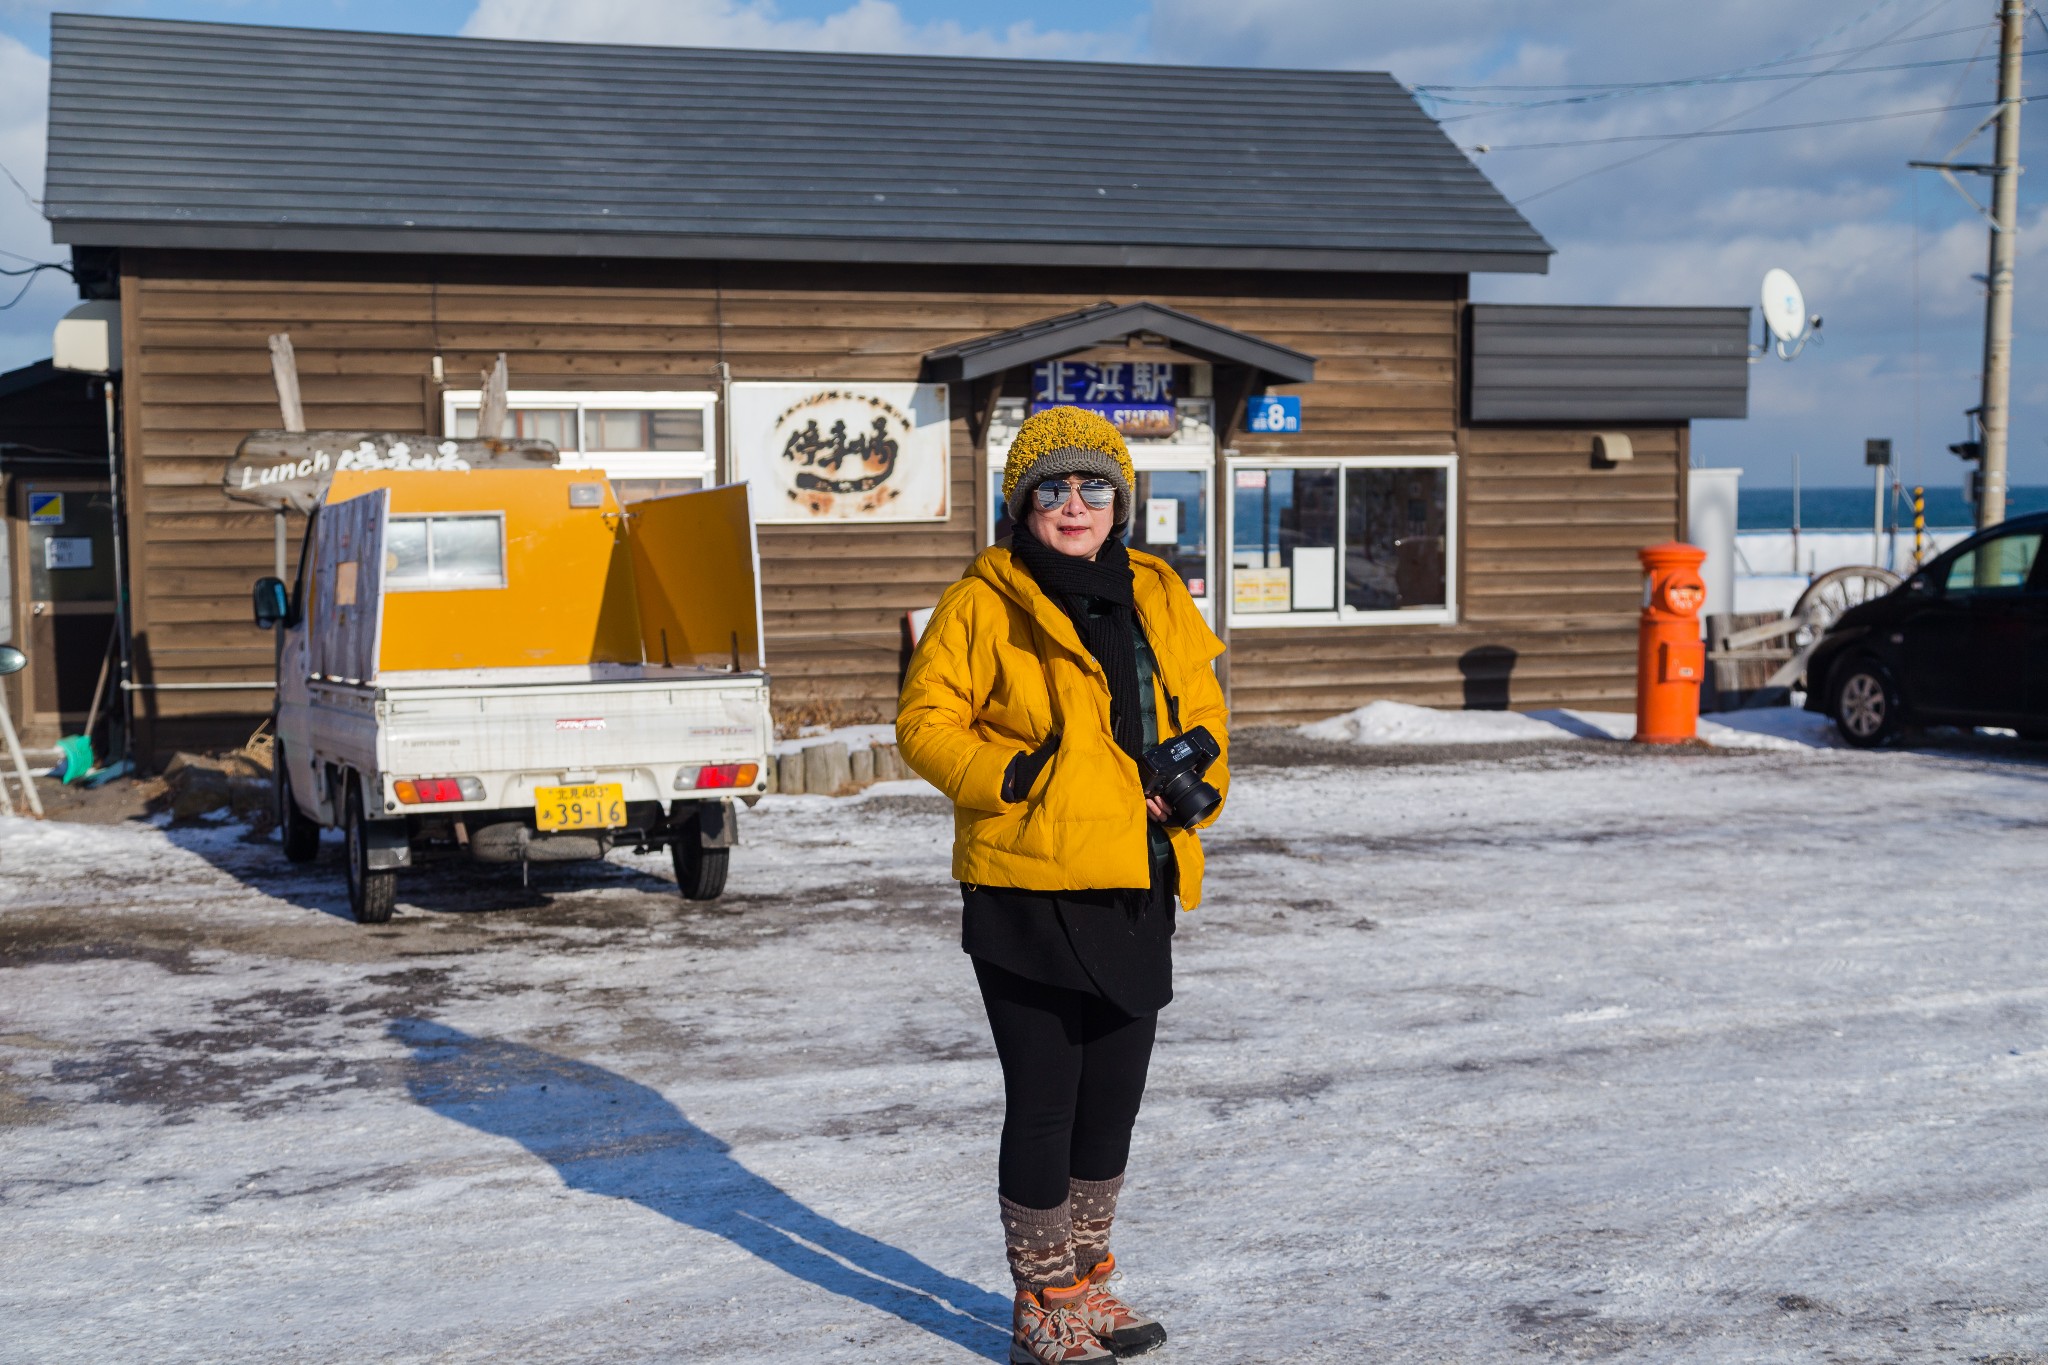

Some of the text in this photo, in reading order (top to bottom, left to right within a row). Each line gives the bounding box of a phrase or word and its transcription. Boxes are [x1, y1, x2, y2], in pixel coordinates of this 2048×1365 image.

[1034, 361, 1173, 402] 北浜駅
[1113, 408, 1170, 428] STATION
[241, 449, 331, 491] Lunch
[556, 800, 621, 826] 39-16
